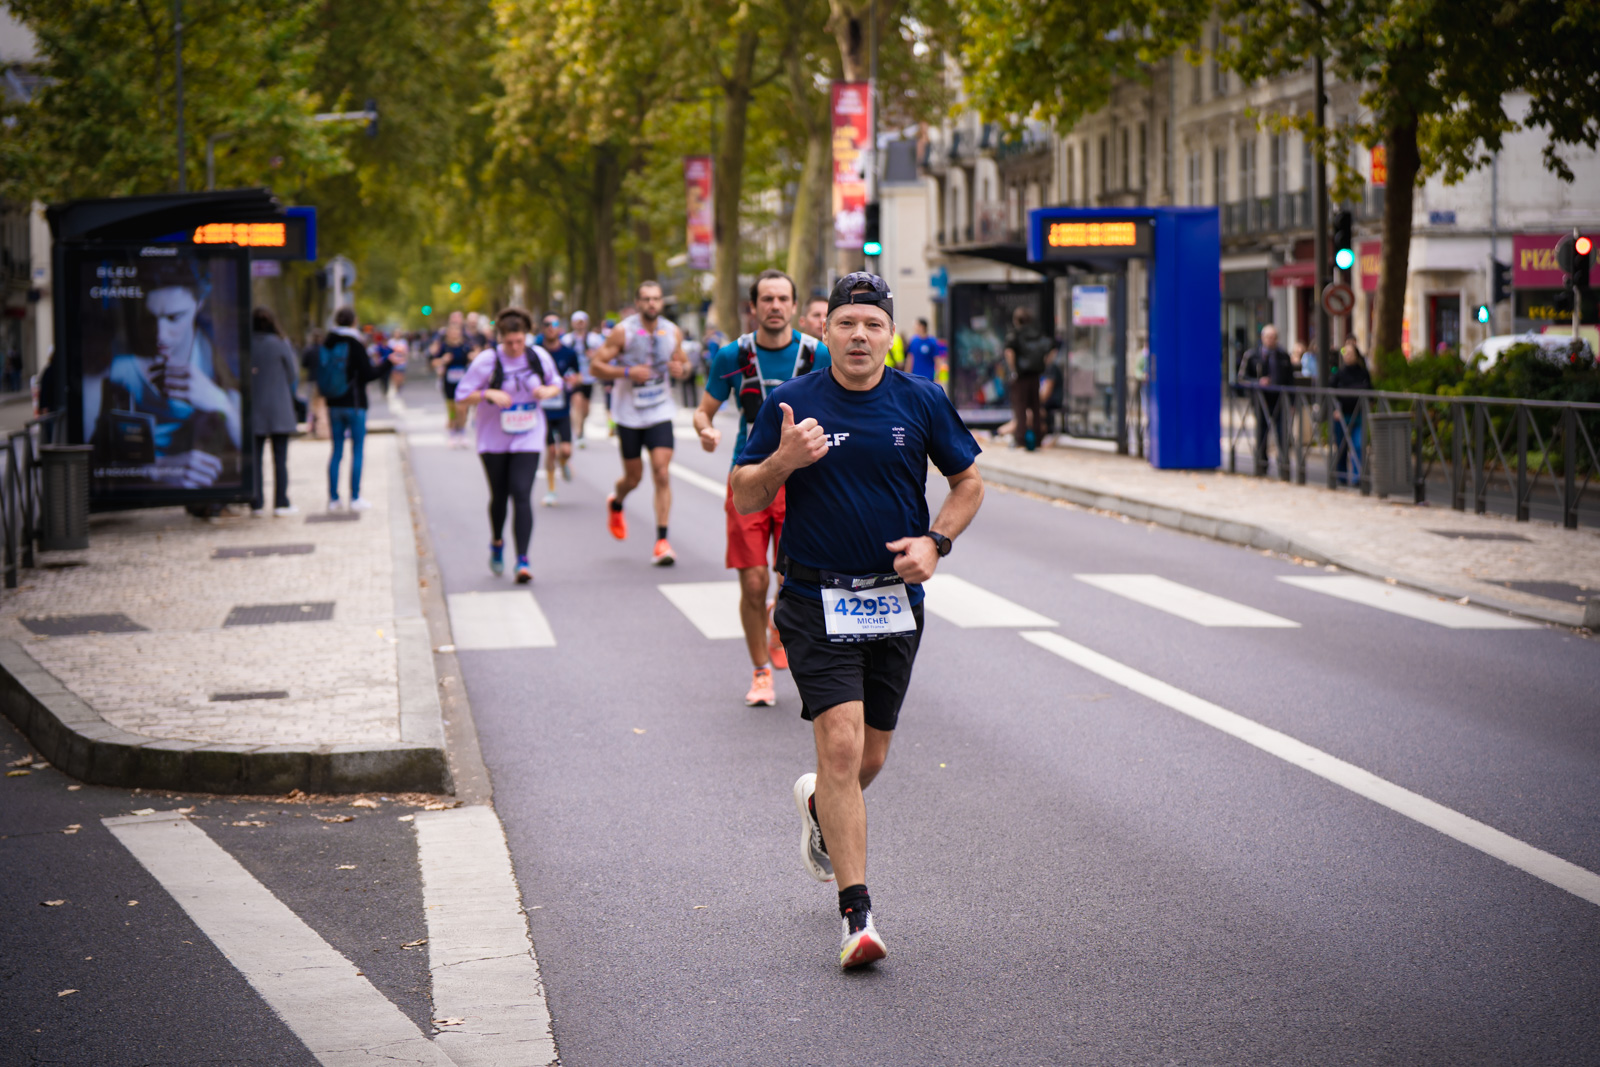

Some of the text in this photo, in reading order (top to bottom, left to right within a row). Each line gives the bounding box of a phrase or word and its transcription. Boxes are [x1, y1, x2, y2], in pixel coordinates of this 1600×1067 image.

[96, 266, 138, 278] BLEU
[89, 286, 144, 299] CHANEL
[834, 595, 902, 616] 42953
[857, 616, 889, 625] MICHEL
